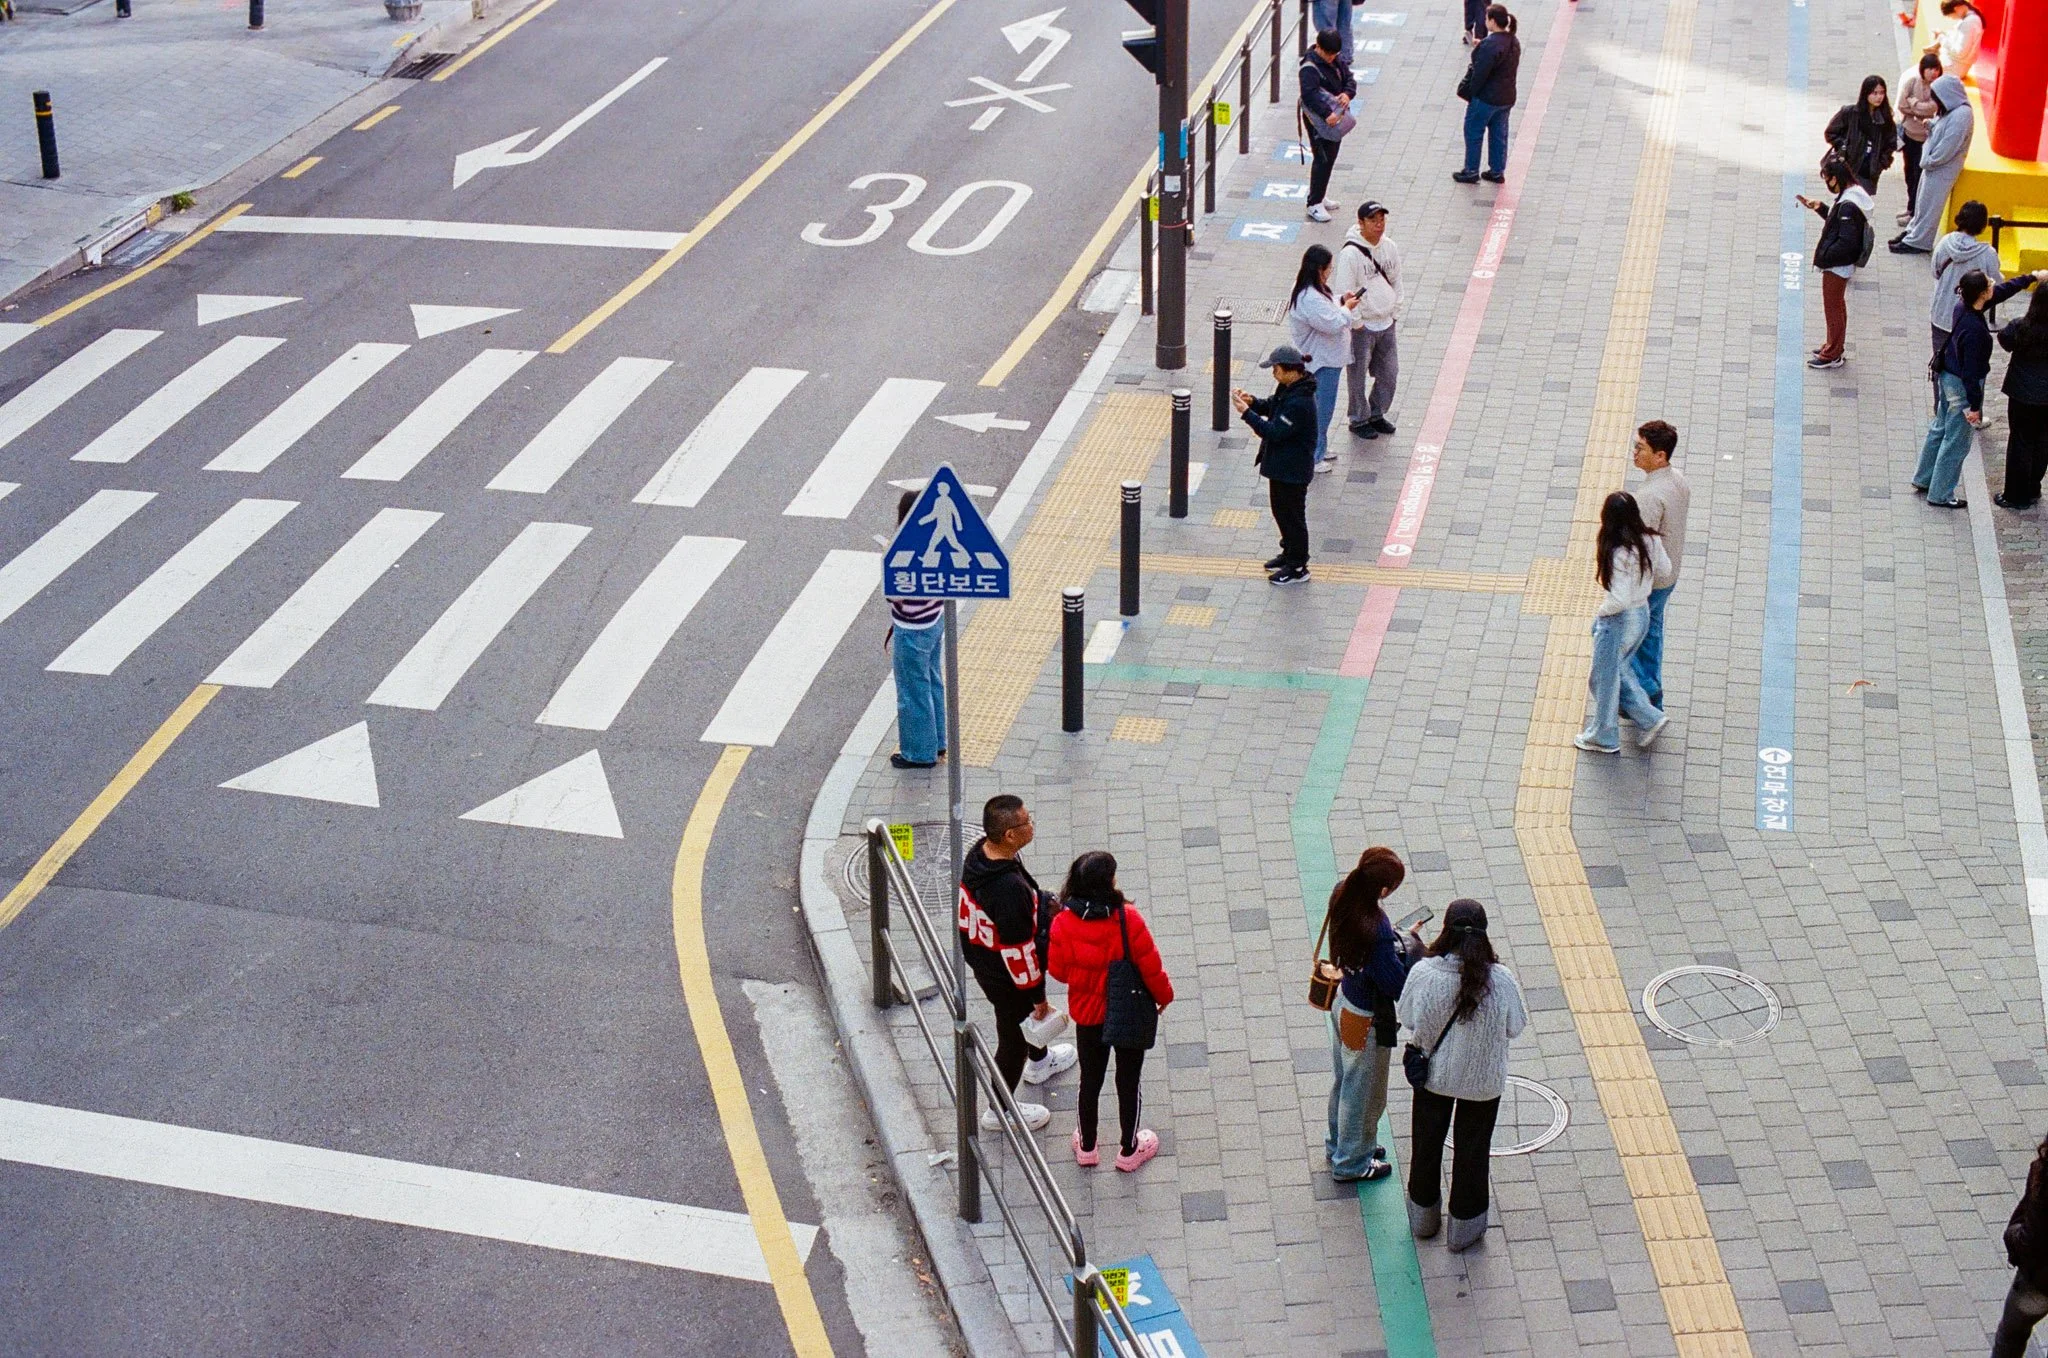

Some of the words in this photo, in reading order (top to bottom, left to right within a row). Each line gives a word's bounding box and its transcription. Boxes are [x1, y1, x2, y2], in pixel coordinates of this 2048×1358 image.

[800, 172, 1033, 256] 30
[893, 571, 1000, 594] 횡단보도
[1761, 764, 1788, 830] 연무장길
